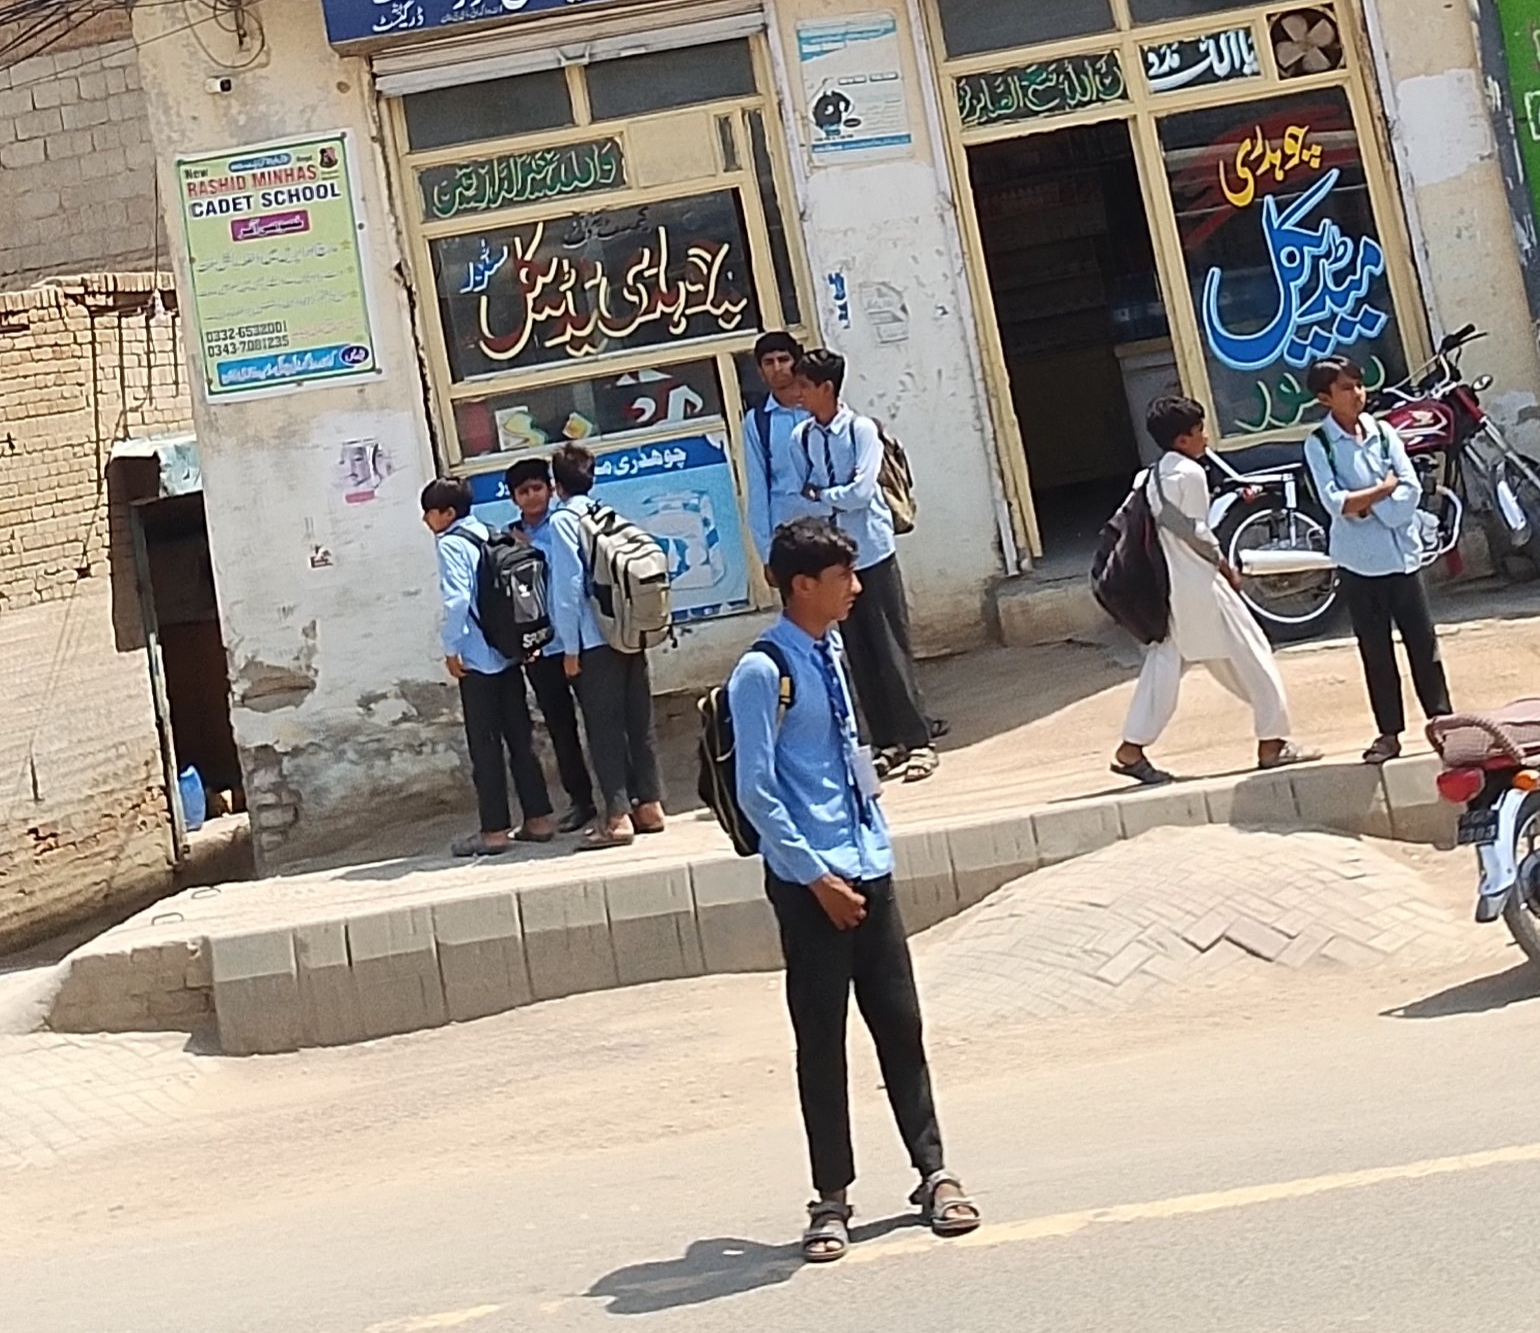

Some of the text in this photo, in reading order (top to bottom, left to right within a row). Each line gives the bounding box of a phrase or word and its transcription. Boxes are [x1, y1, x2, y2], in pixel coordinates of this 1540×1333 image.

[184, 168, 208, 180] New
[187, 175, 247, 198] RASHID
[252, 163, 318, 190] MINHAS
[1219, 124, 1323, 208] چوہدری
[190, 182, 341, 219] CADET SCHOOL
[459, 238, 508, 294] سٹور
[1202, 167, 1388, 371] میڈیکل
